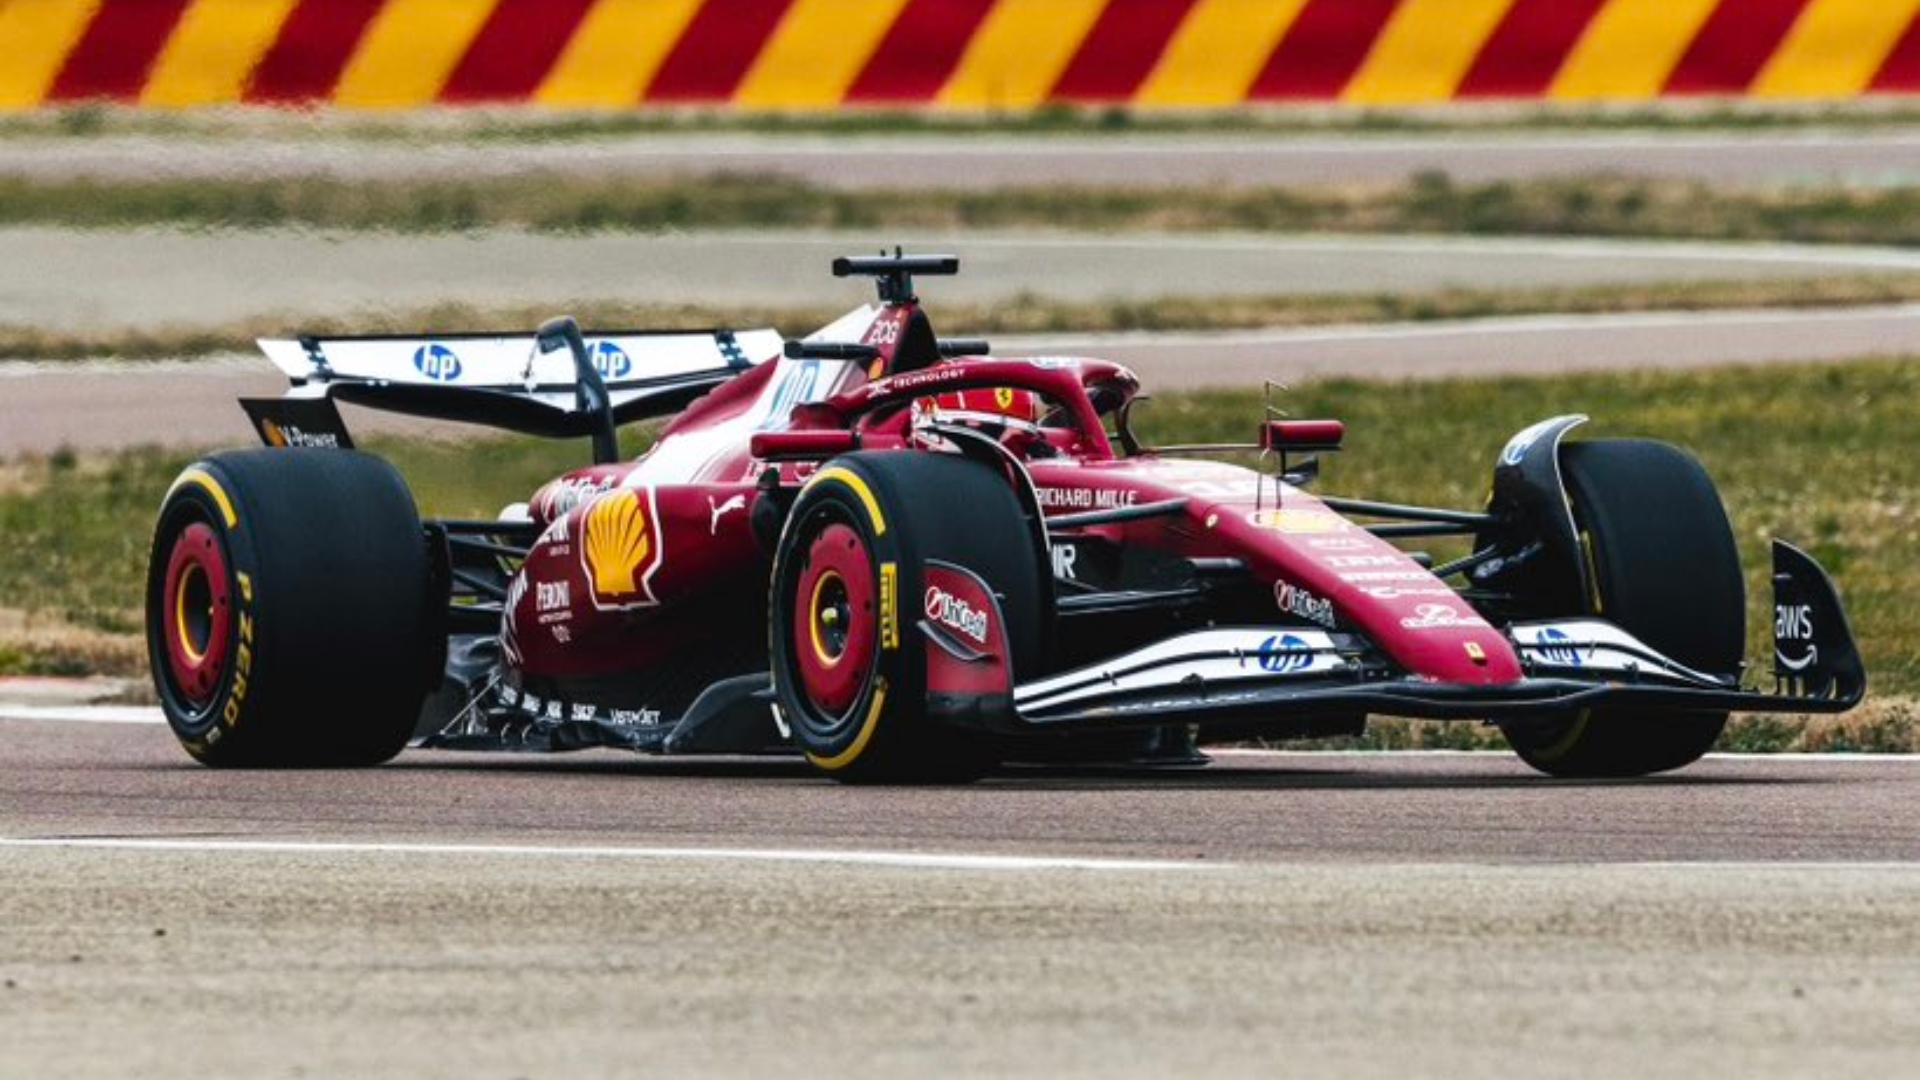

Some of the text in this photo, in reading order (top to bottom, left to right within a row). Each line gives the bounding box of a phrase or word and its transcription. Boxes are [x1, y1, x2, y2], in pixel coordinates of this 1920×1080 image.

[417, 343, 461, 382] hp
[588, 341, 630, 379] hp
[893, 368, 965, 389] TECHNOLOGY
[1036, 487, 1137, 510] RICHARD MILLE
[940, 591, 988, 644] UniCredit
[1775, 604, 1814, 639] aws
[224, 570, 253, 726] P ZERO
